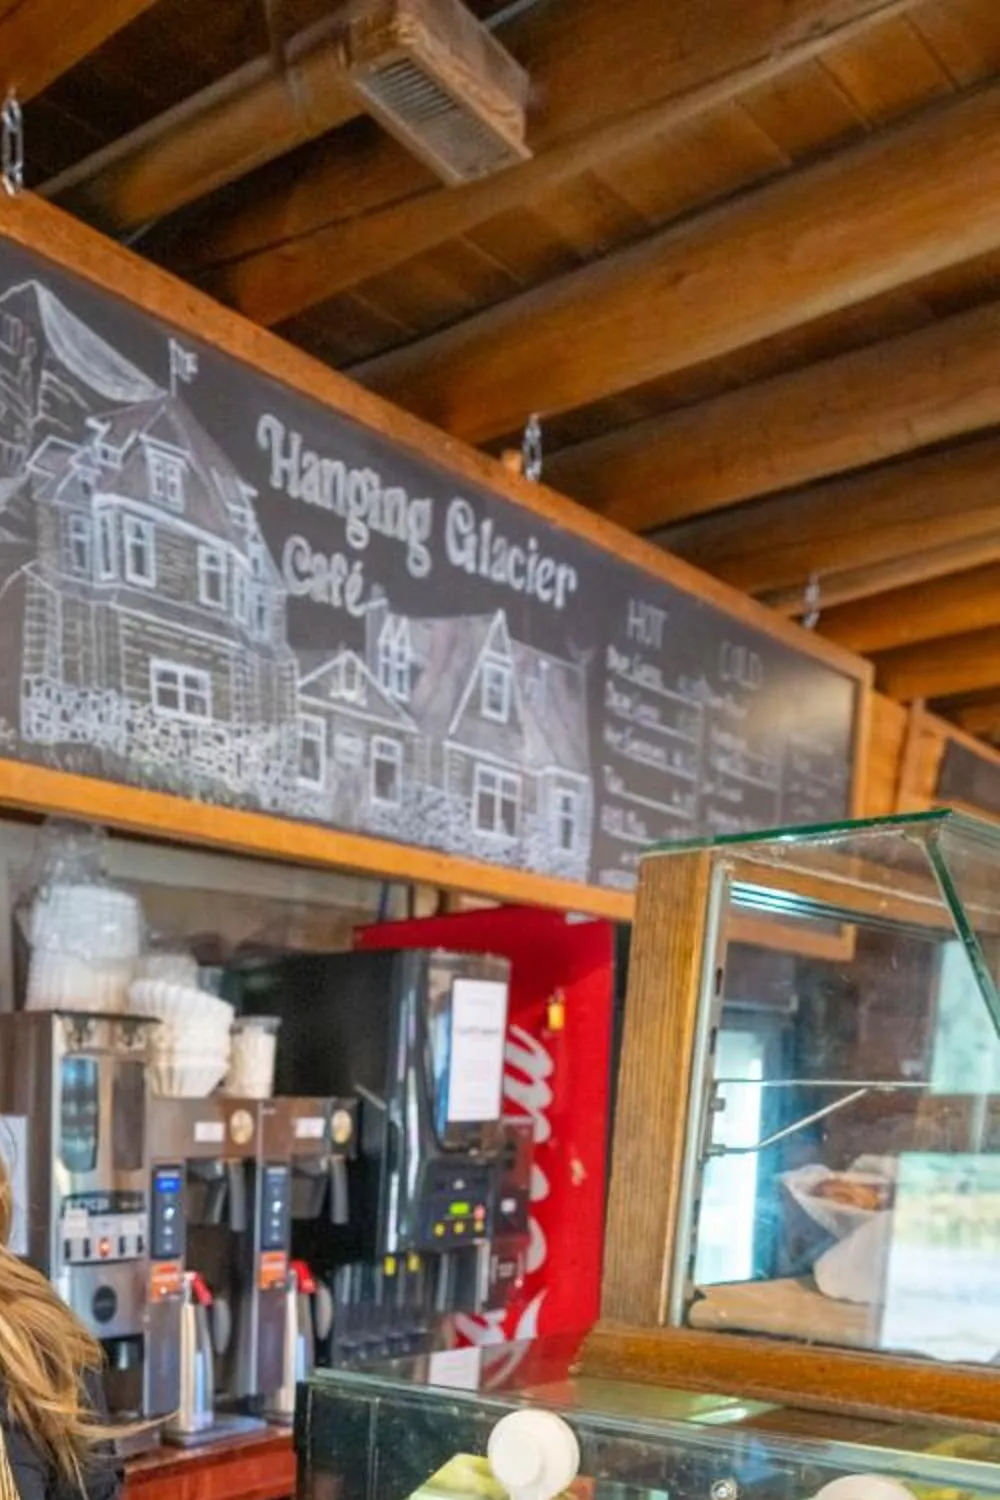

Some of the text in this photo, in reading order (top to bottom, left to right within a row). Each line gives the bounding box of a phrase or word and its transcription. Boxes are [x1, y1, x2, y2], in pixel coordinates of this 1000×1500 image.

[256, 412, 578, 610] Hanging Glacier
[281, 534, 389, 617] Café
